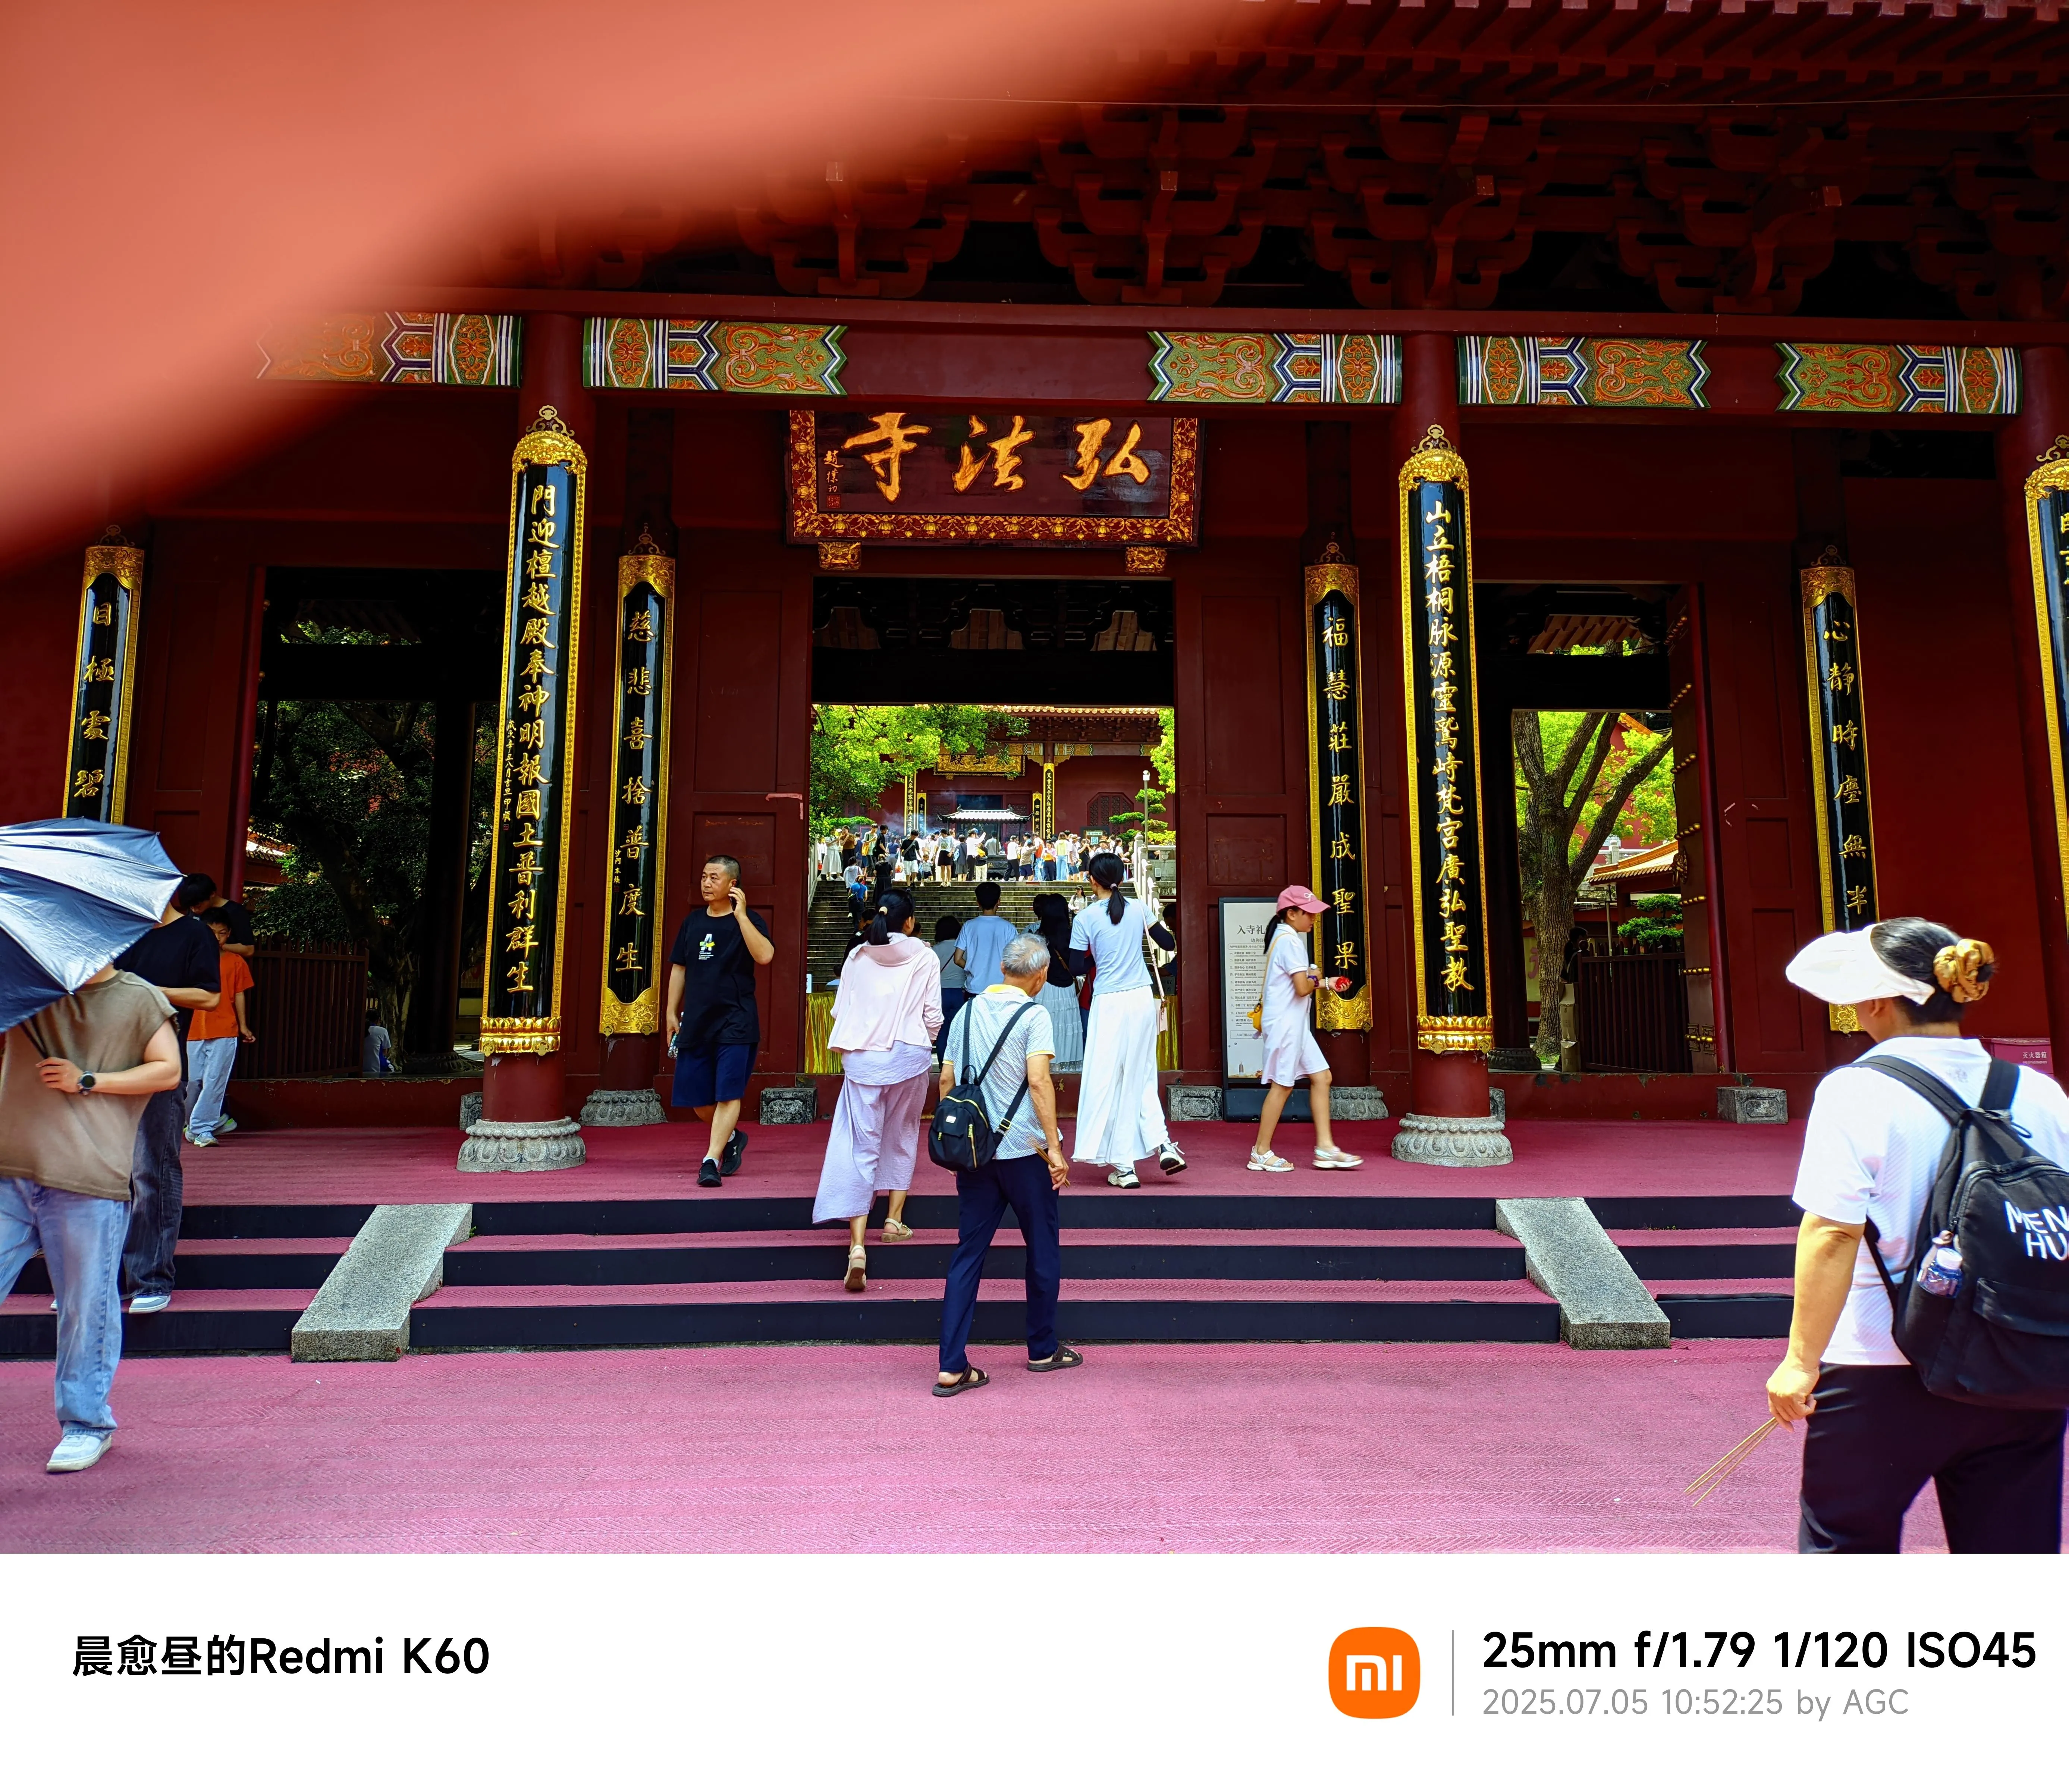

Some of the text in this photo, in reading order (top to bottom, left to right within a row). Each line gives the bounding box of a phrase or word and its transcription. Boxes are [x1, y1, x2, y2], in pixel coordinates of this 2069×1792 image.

[841, 412, 1152, 504] 弘法寺
[1322, 617, 1358, 969] 福慧莊嚴成聖果
[1237, 925, 1268, 935] 入寺礼
